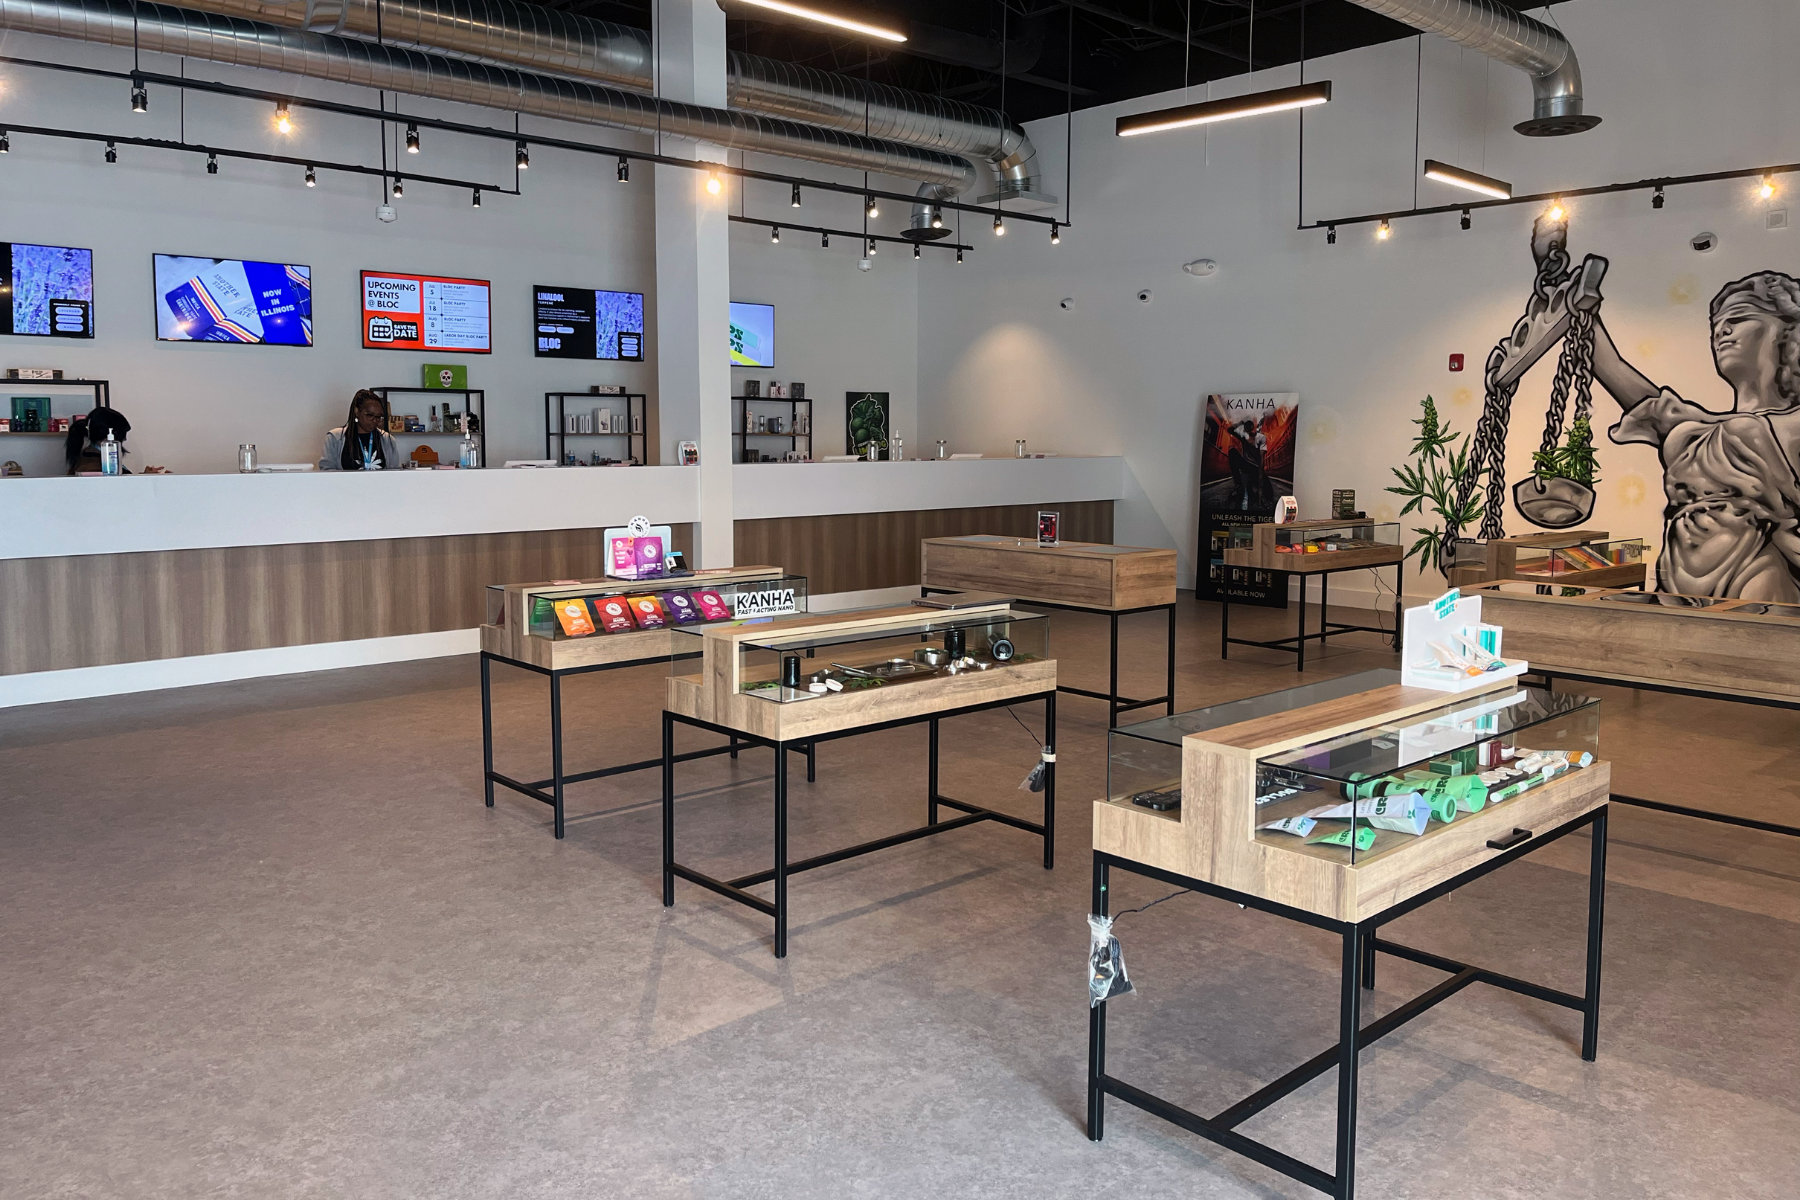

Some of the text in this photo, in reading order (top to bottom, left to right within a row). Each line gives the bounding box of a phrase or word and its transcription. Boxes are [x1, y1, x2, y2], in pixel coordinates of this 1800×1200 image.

[212, 281, 231, 296] STATE
[368, 281, 416, 292] UPCOMING
[262, 289, 282, 298] NOW
[368, 291, 400, 300] EVENTS
[260, 304, 295, 316] ILLINOIS
[394, 329, 418, 338] DATE
[538, 337, 561, 349] BLOC
[1226, 398, 1276, 410] KANHA
[1216, 588, 1248, 596] AVILABLE
[736, 591, 794, 609] KANHA
[1439, 603, 1455, 619] STATE
